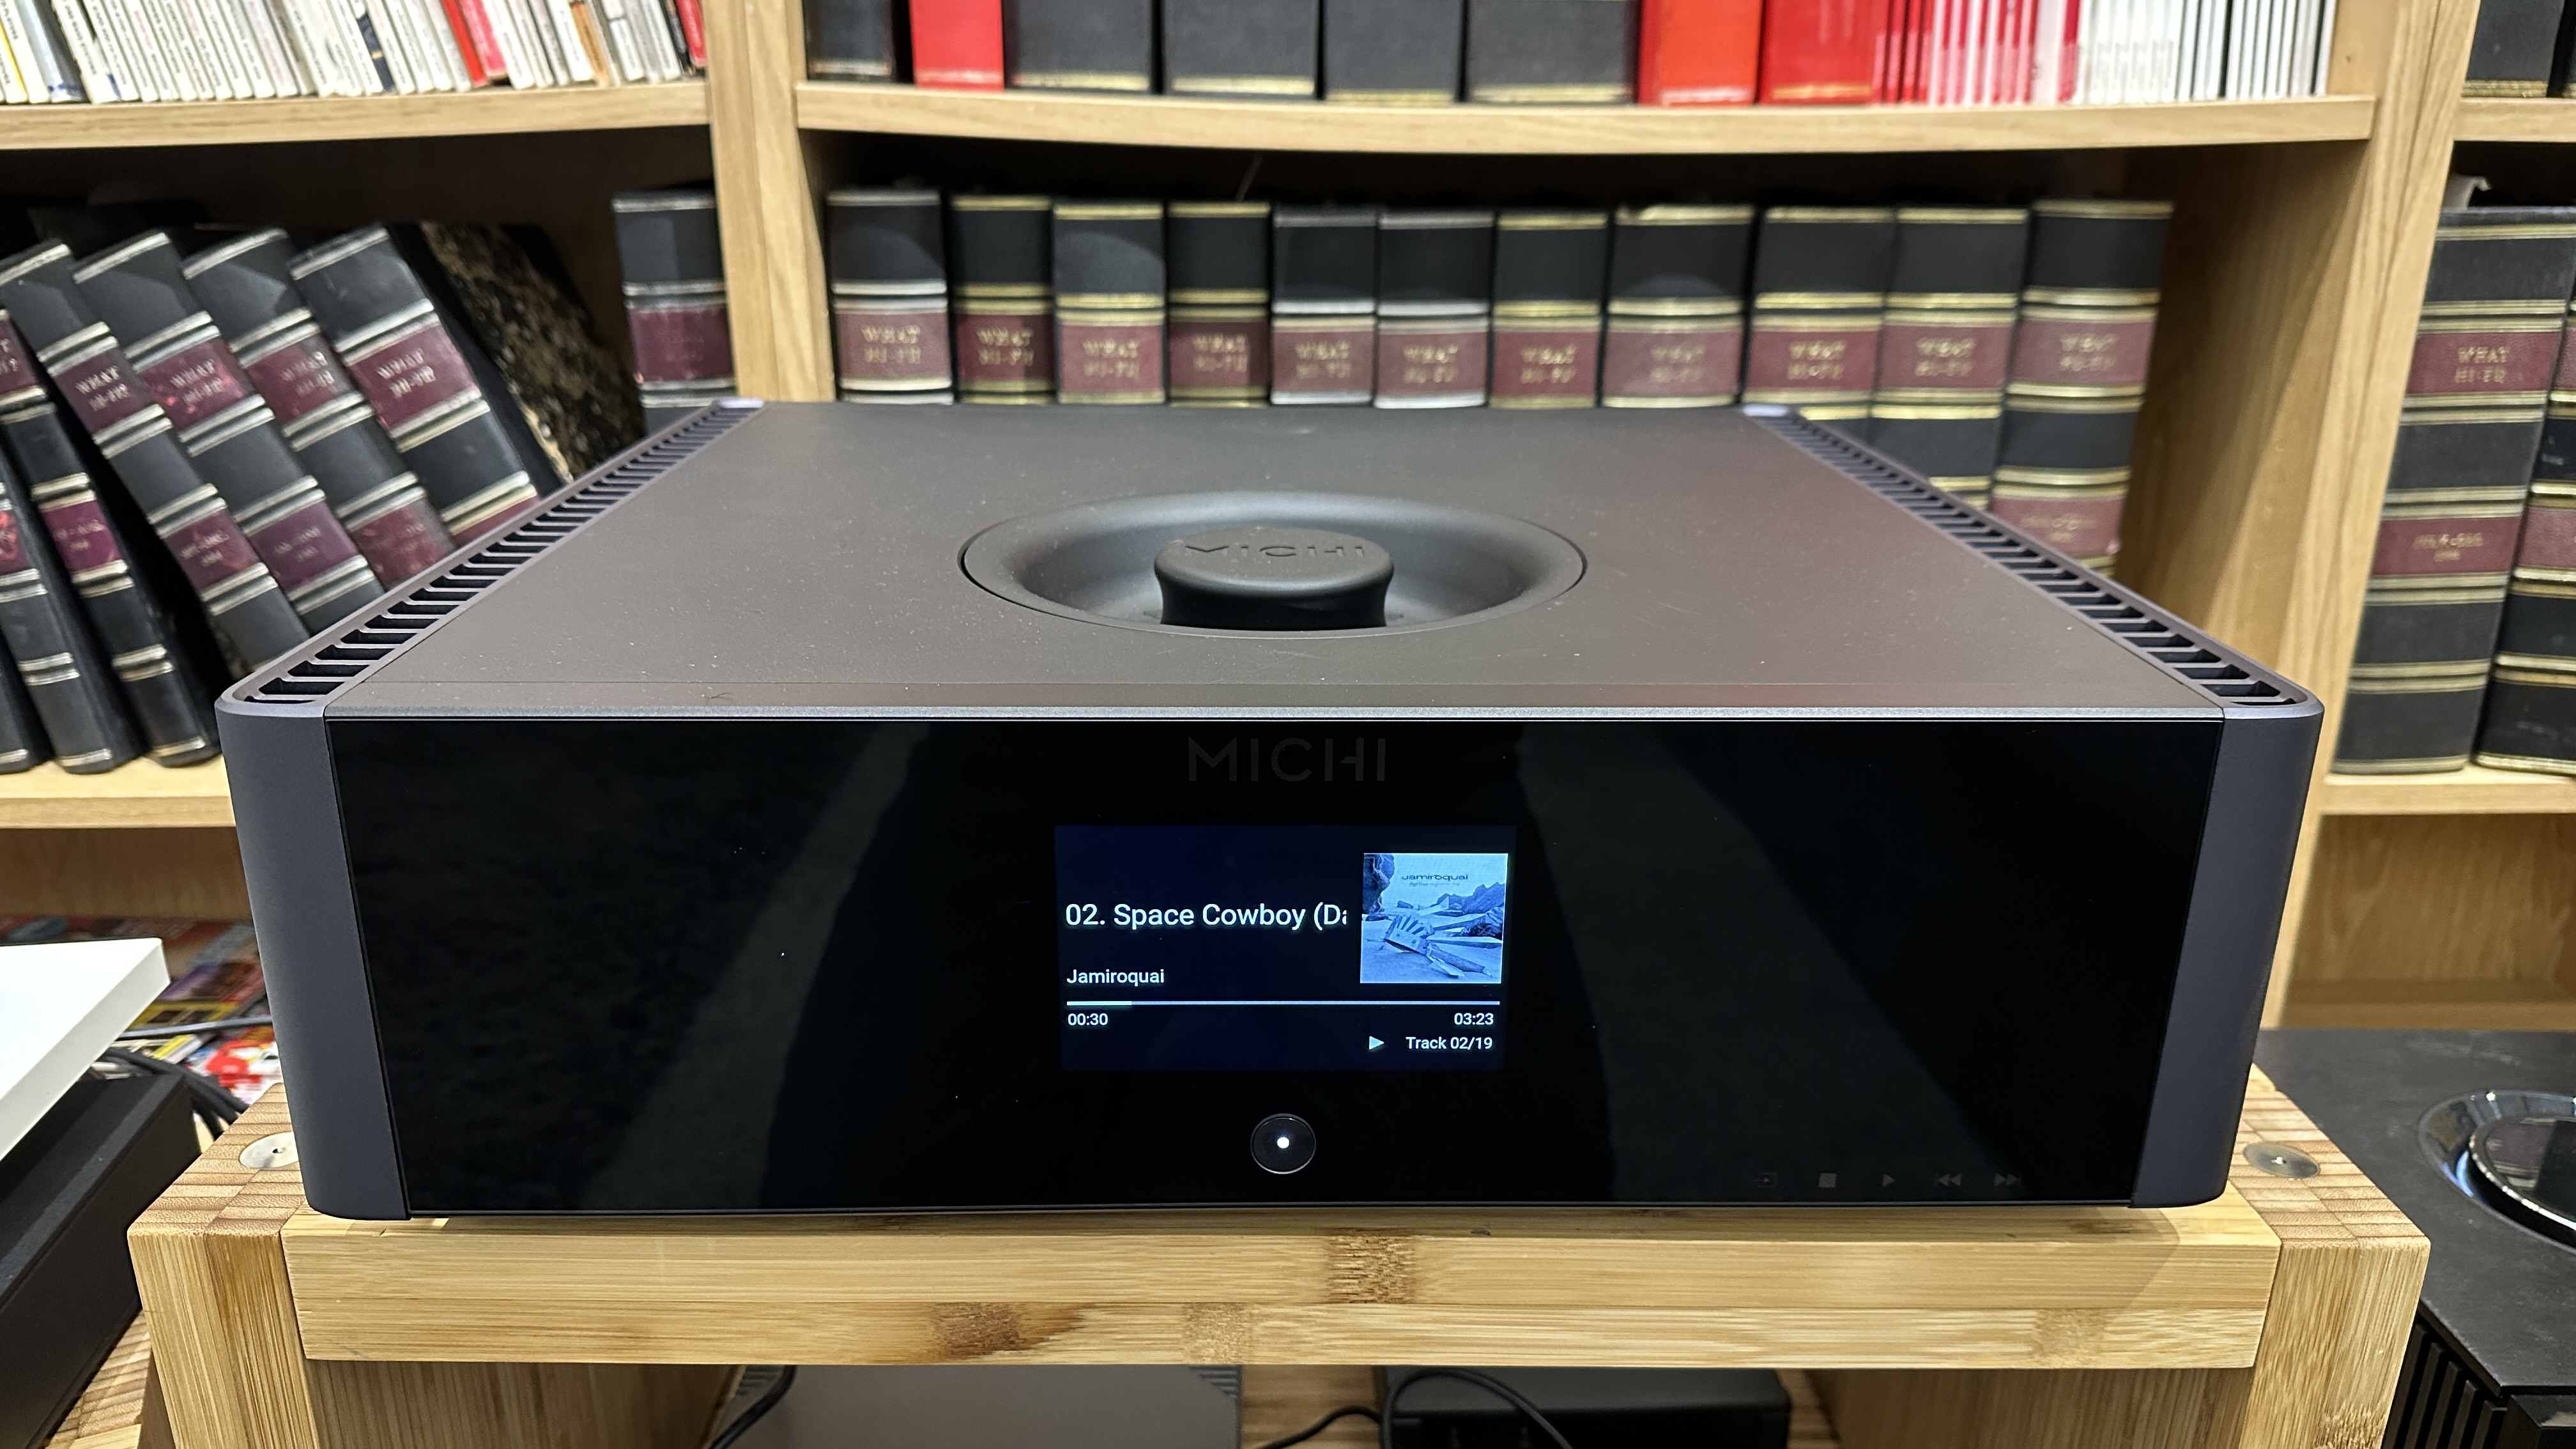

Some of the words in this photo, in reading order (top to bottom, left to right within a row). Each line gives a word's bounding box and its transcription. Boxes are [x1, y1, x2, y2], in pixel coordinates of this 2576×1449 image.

[1184, 545, 1365, 558] MICHI
[1188, 737, 1386, 781] MICHI
[1066, 903, 1105, 926] 02.
[1114, 903, 1195, 930] Space
[1202, 903, 1307, 931] Cowboy
[1066, 969, 1165, 987] Jamiroquai
[1068, 1013, 1108, 1026] 00:30
[1453, 1012, 1494, 1025] 03:23
[1406, 1036, 1447, 1050] Track
[1450, 1036, 1493, 1050] 02/19
